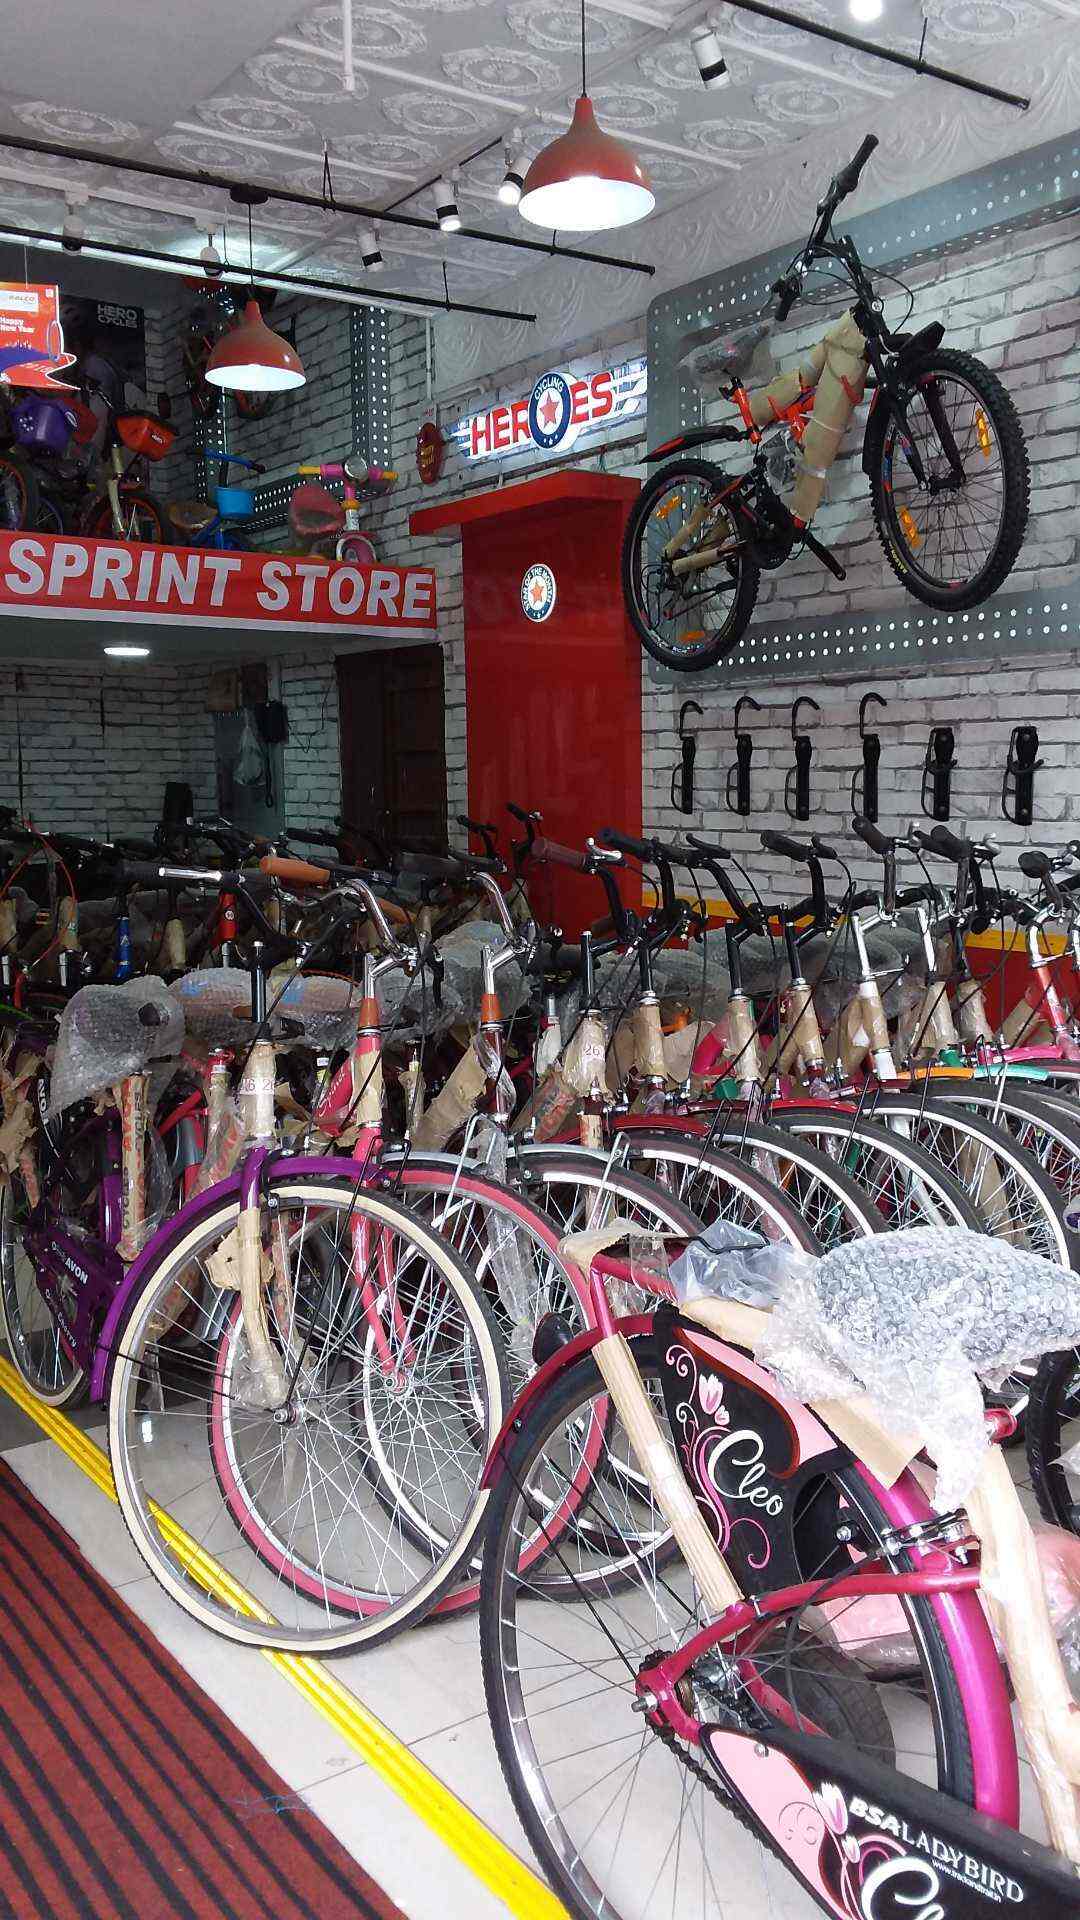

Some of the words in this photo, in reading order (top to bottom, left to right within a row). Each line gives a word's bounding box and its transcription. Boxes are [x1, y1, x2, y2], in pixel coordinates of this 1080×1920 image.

[97, 304, 138, 321] HERO
[97, 314, 138, 328] CYCLES
[534, 376, 563, 400] CYCLING
[472, 372, 613, 455] HEROES
[5, 539, 242, 607] SPRINT
[256, 560, 433, 618] STORE
[65, 1259, 88, 1284] AVON
[707, 1429, 784, 1516] Cleo
